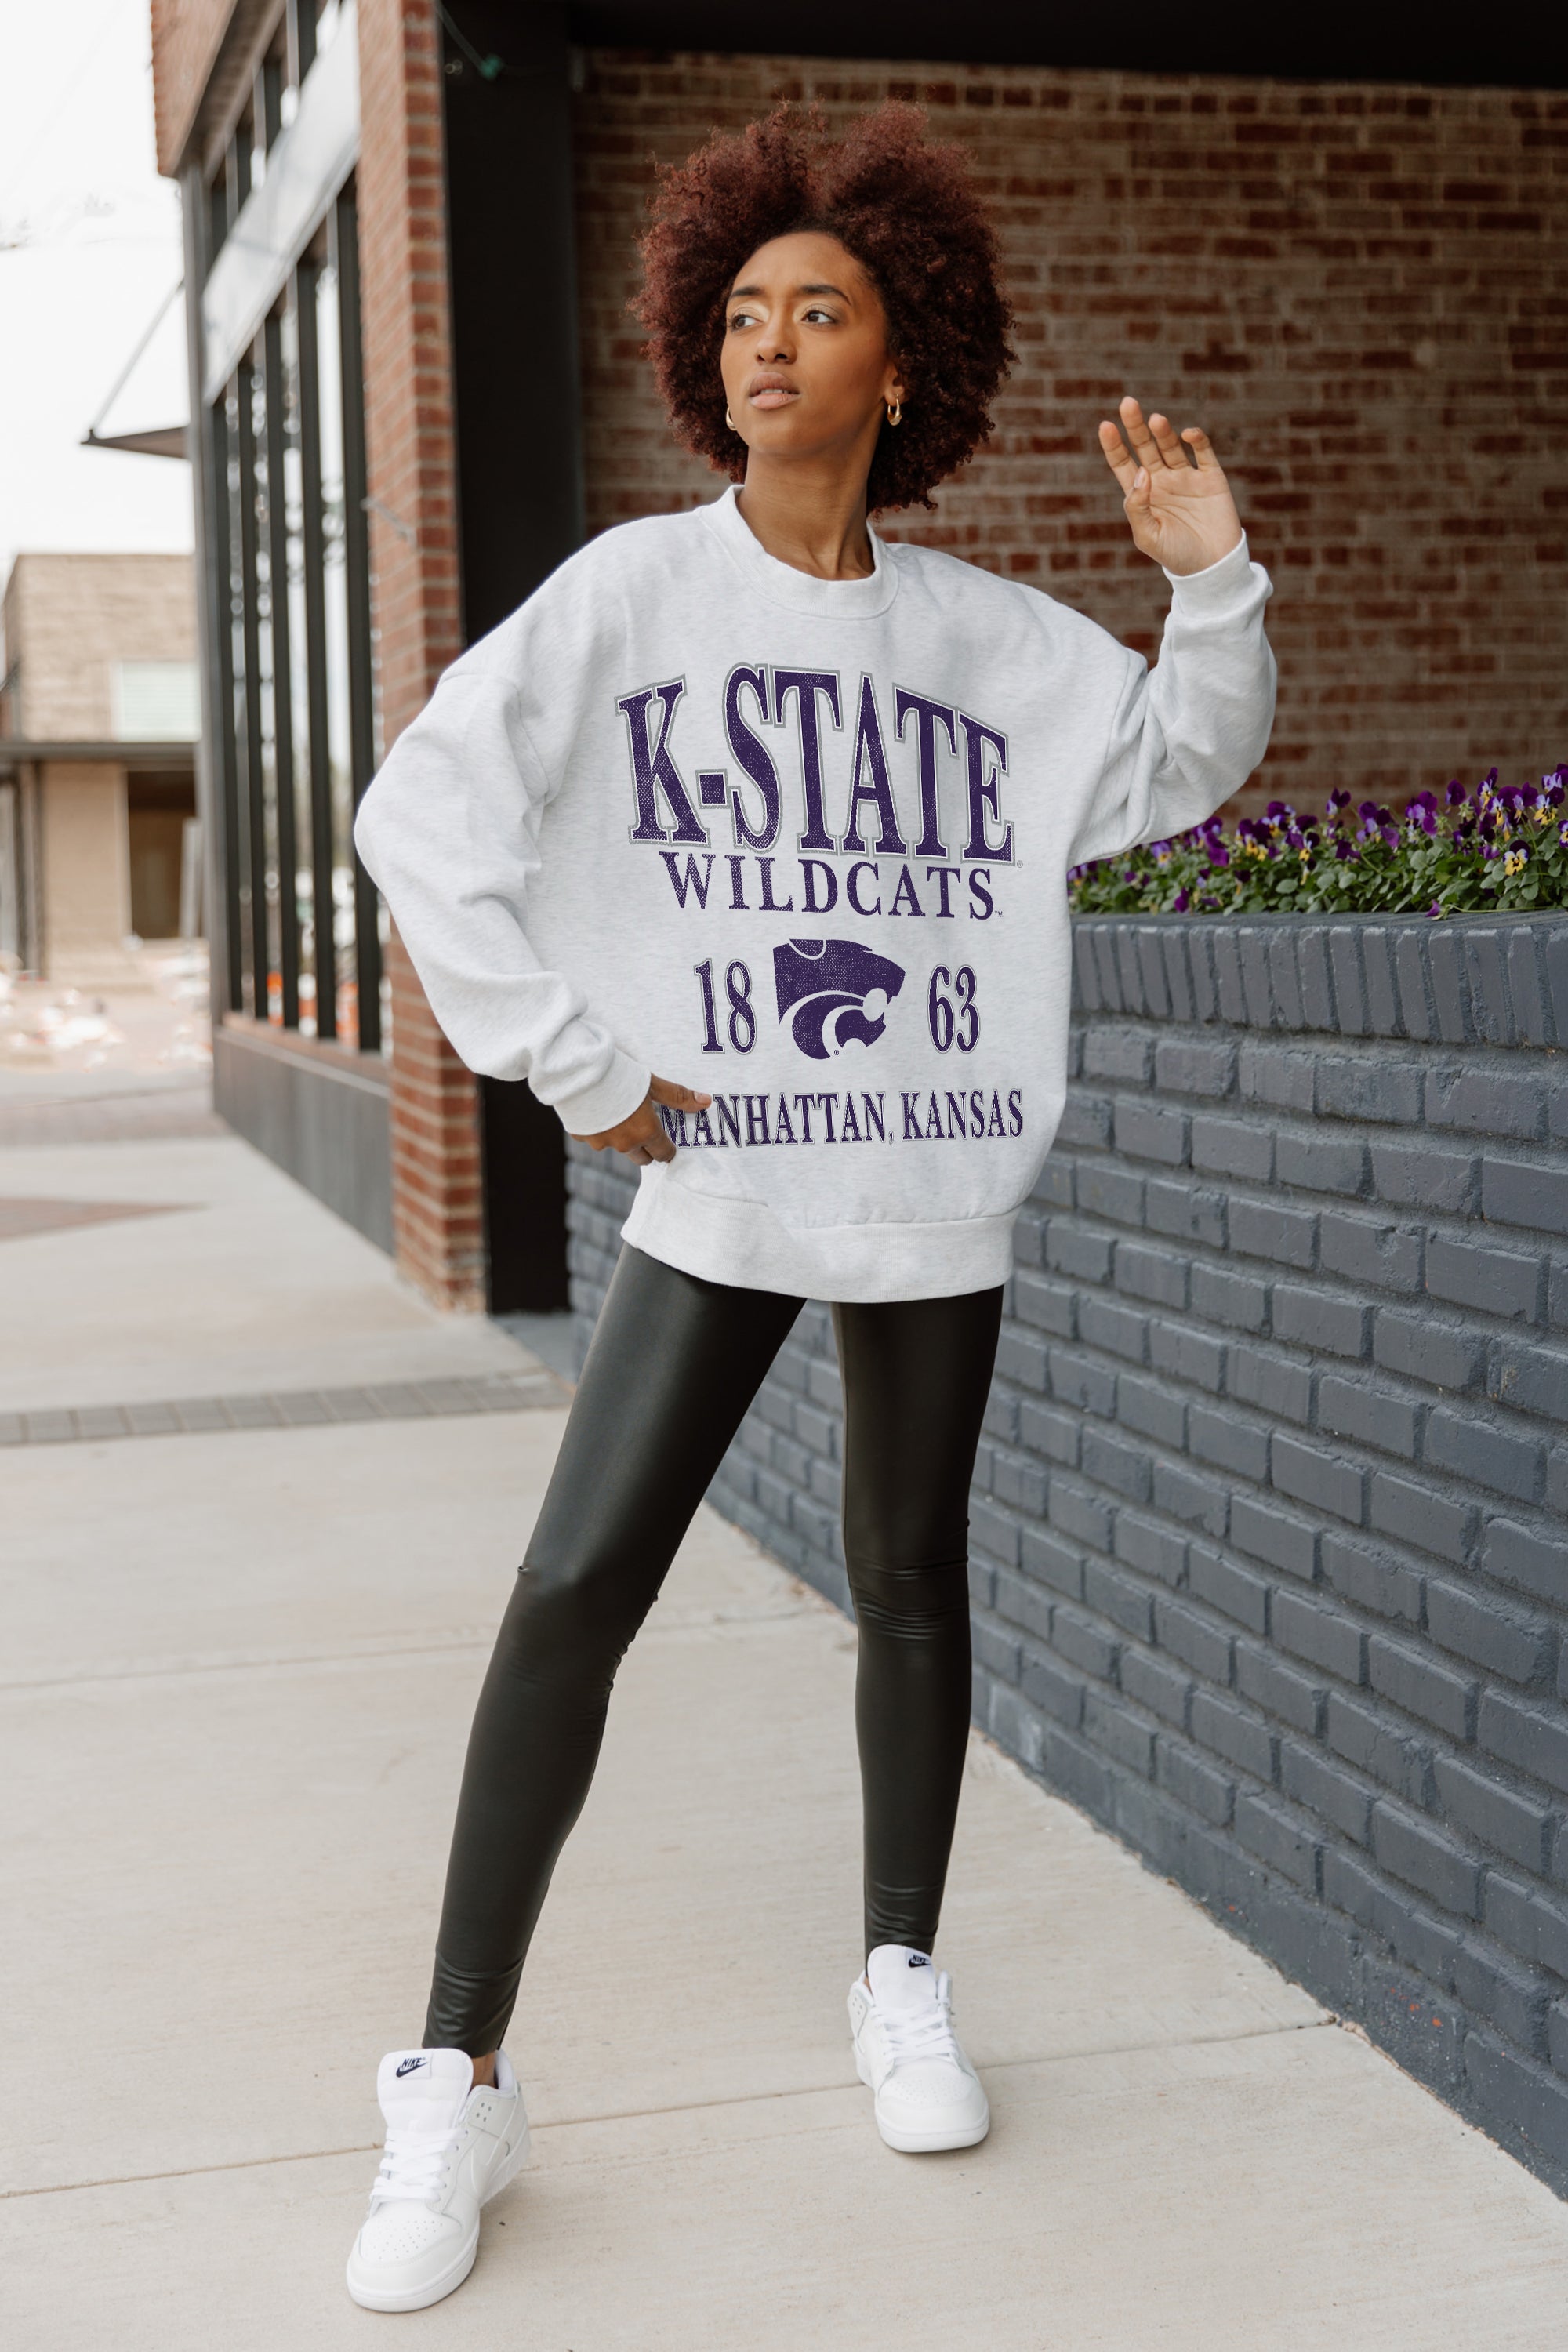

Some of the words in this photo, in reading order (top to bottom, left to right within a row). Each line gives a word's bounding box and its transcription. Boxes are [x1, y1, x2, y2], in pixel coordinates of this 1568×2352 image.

[614, 662, 1016, 867] K-STATE
[659, 851, 993, 920] WILDCATS
[694, 957, 757, 1055] 18
[927, 964, 981, 1054] 63
[899, 1088, 1023, 1141] KANSAS
[401, 2057, 423, 2067] NIKE
